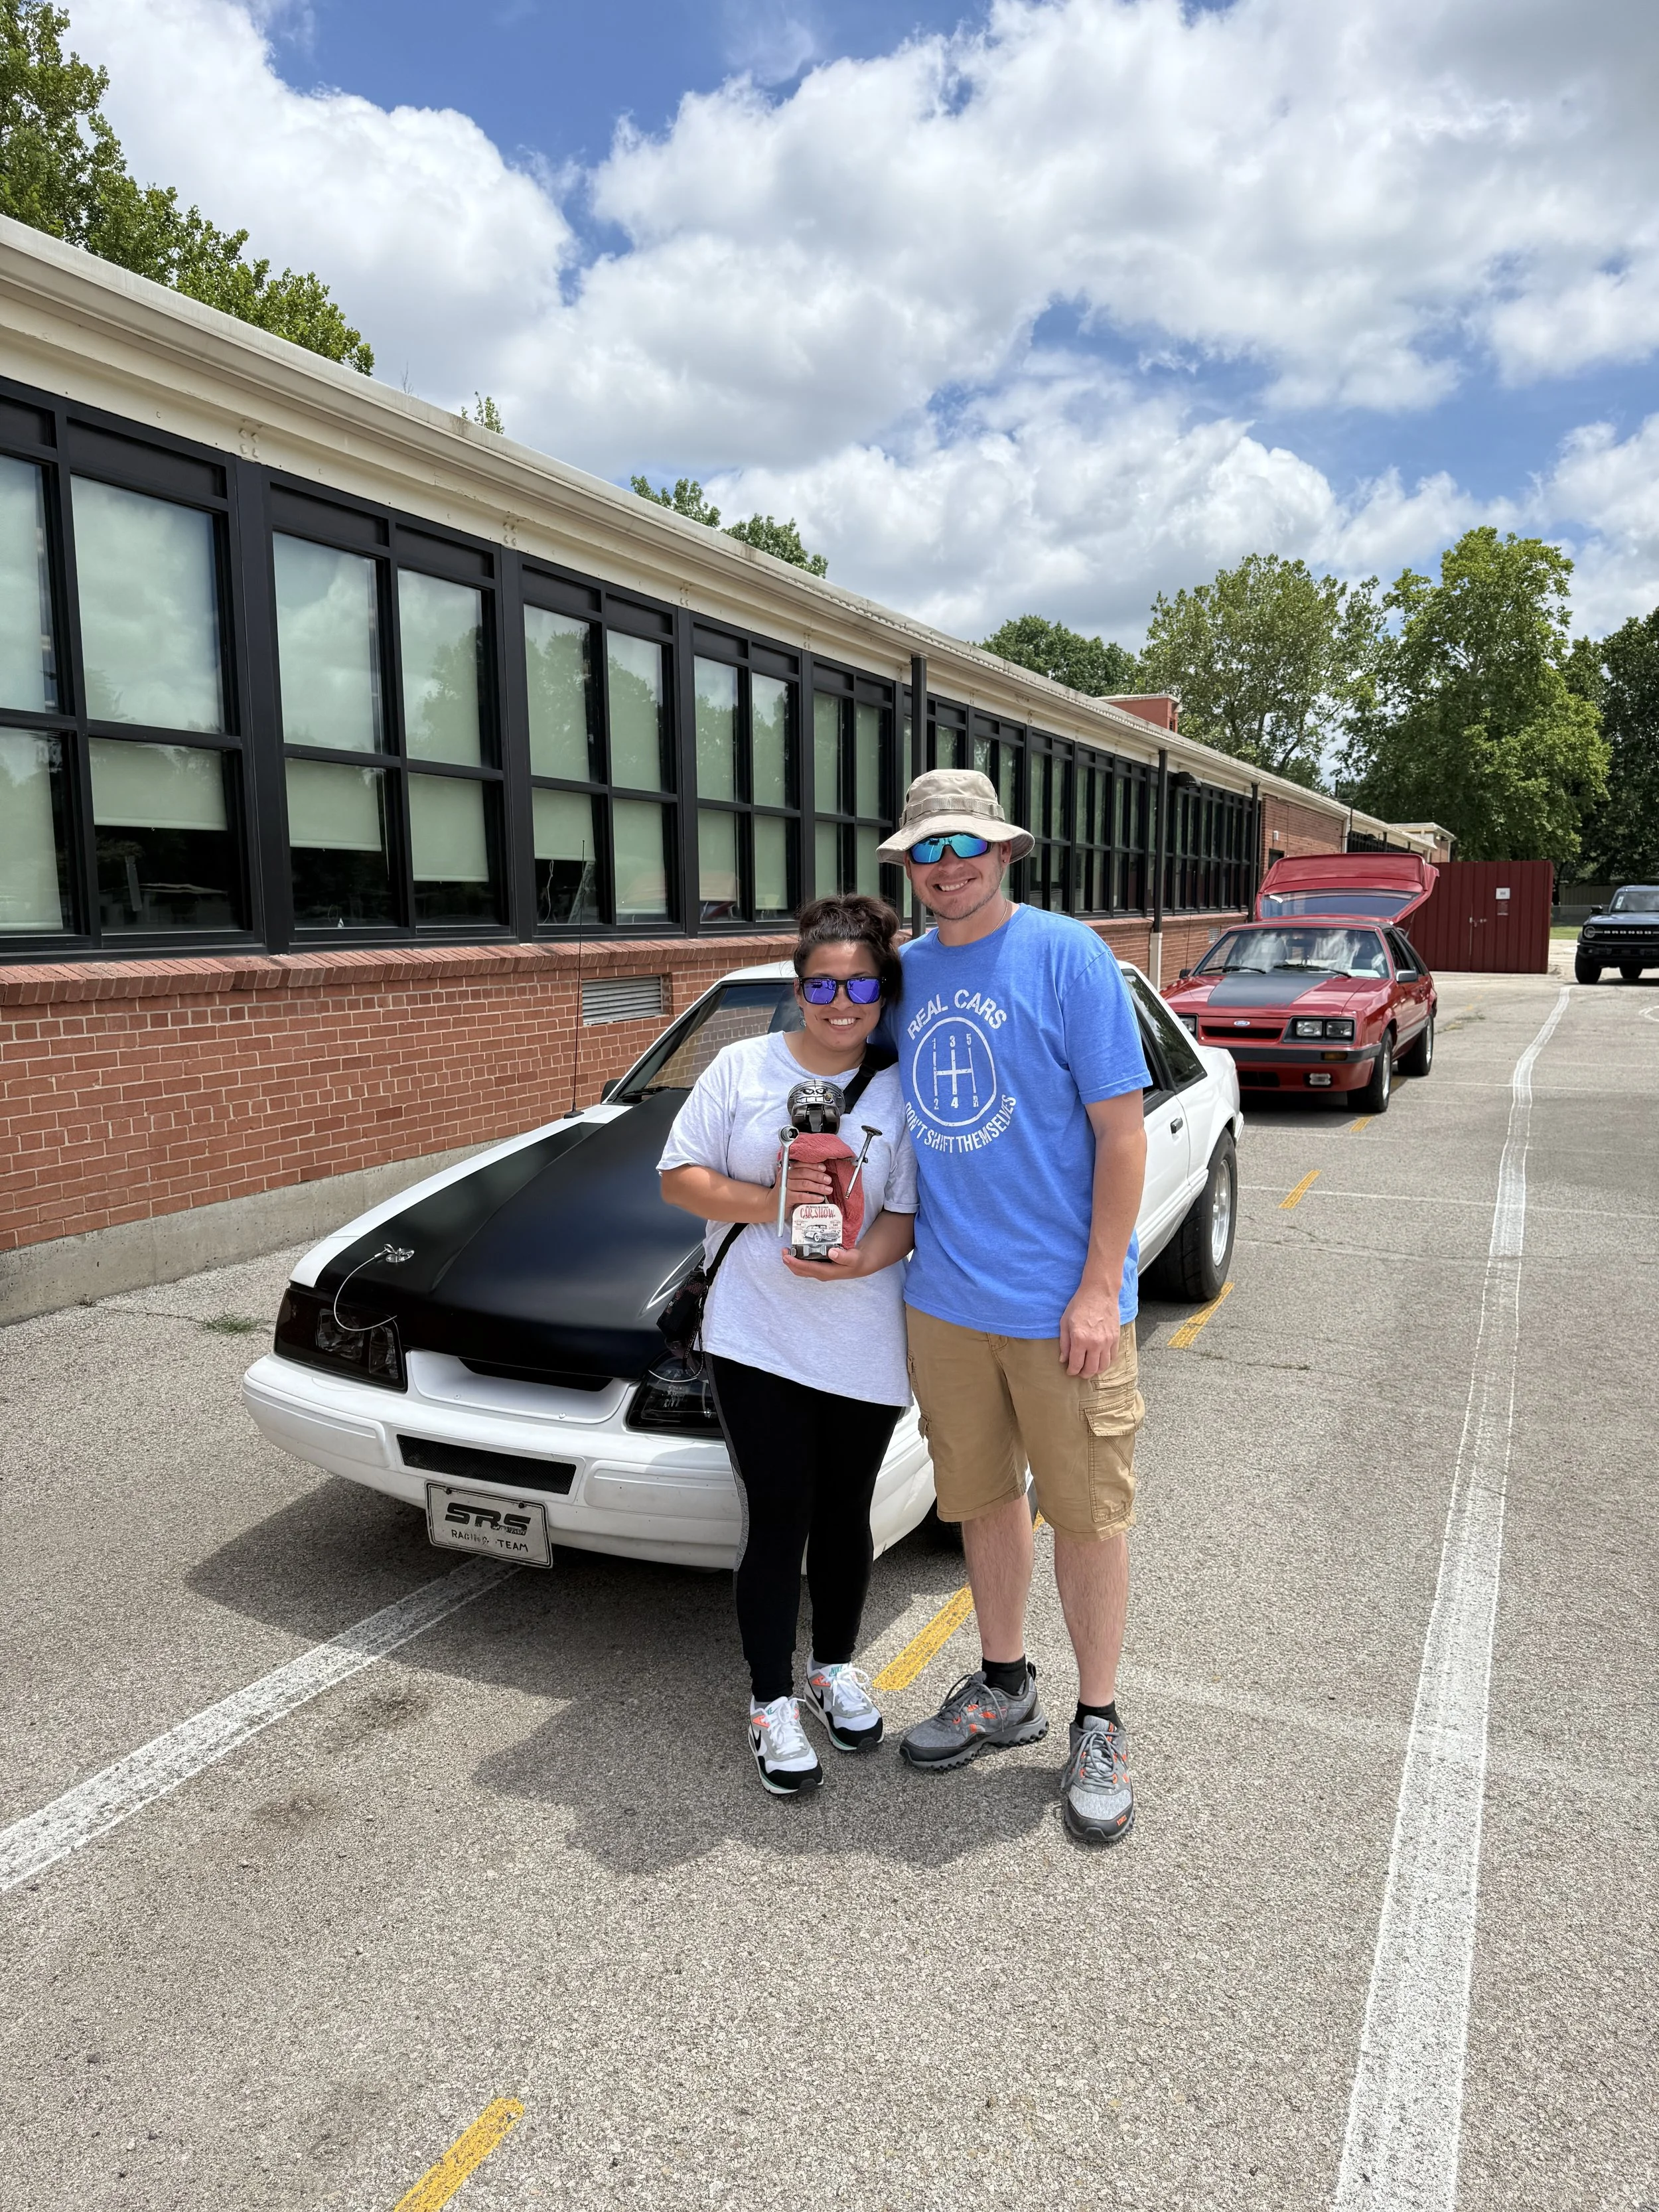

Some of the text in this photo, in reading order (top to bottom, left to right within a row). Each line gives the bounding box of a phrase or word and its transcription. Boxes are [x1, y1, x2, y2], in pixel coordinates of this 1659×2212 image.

[907, 989, 1007, 1041] REAL CARS
[932, 1033, 972, 1049] 1 3 5
[934, 1095, 979, 1110] 2 4 R
[904, 1094, 1017, 1153] DON'T SHIFT THEMSELVES
[800, 1208, 812, 1218] CAR
[445, 1502, 532, 1536] SRS
[496, 1539, 529, 1553] TEAM
